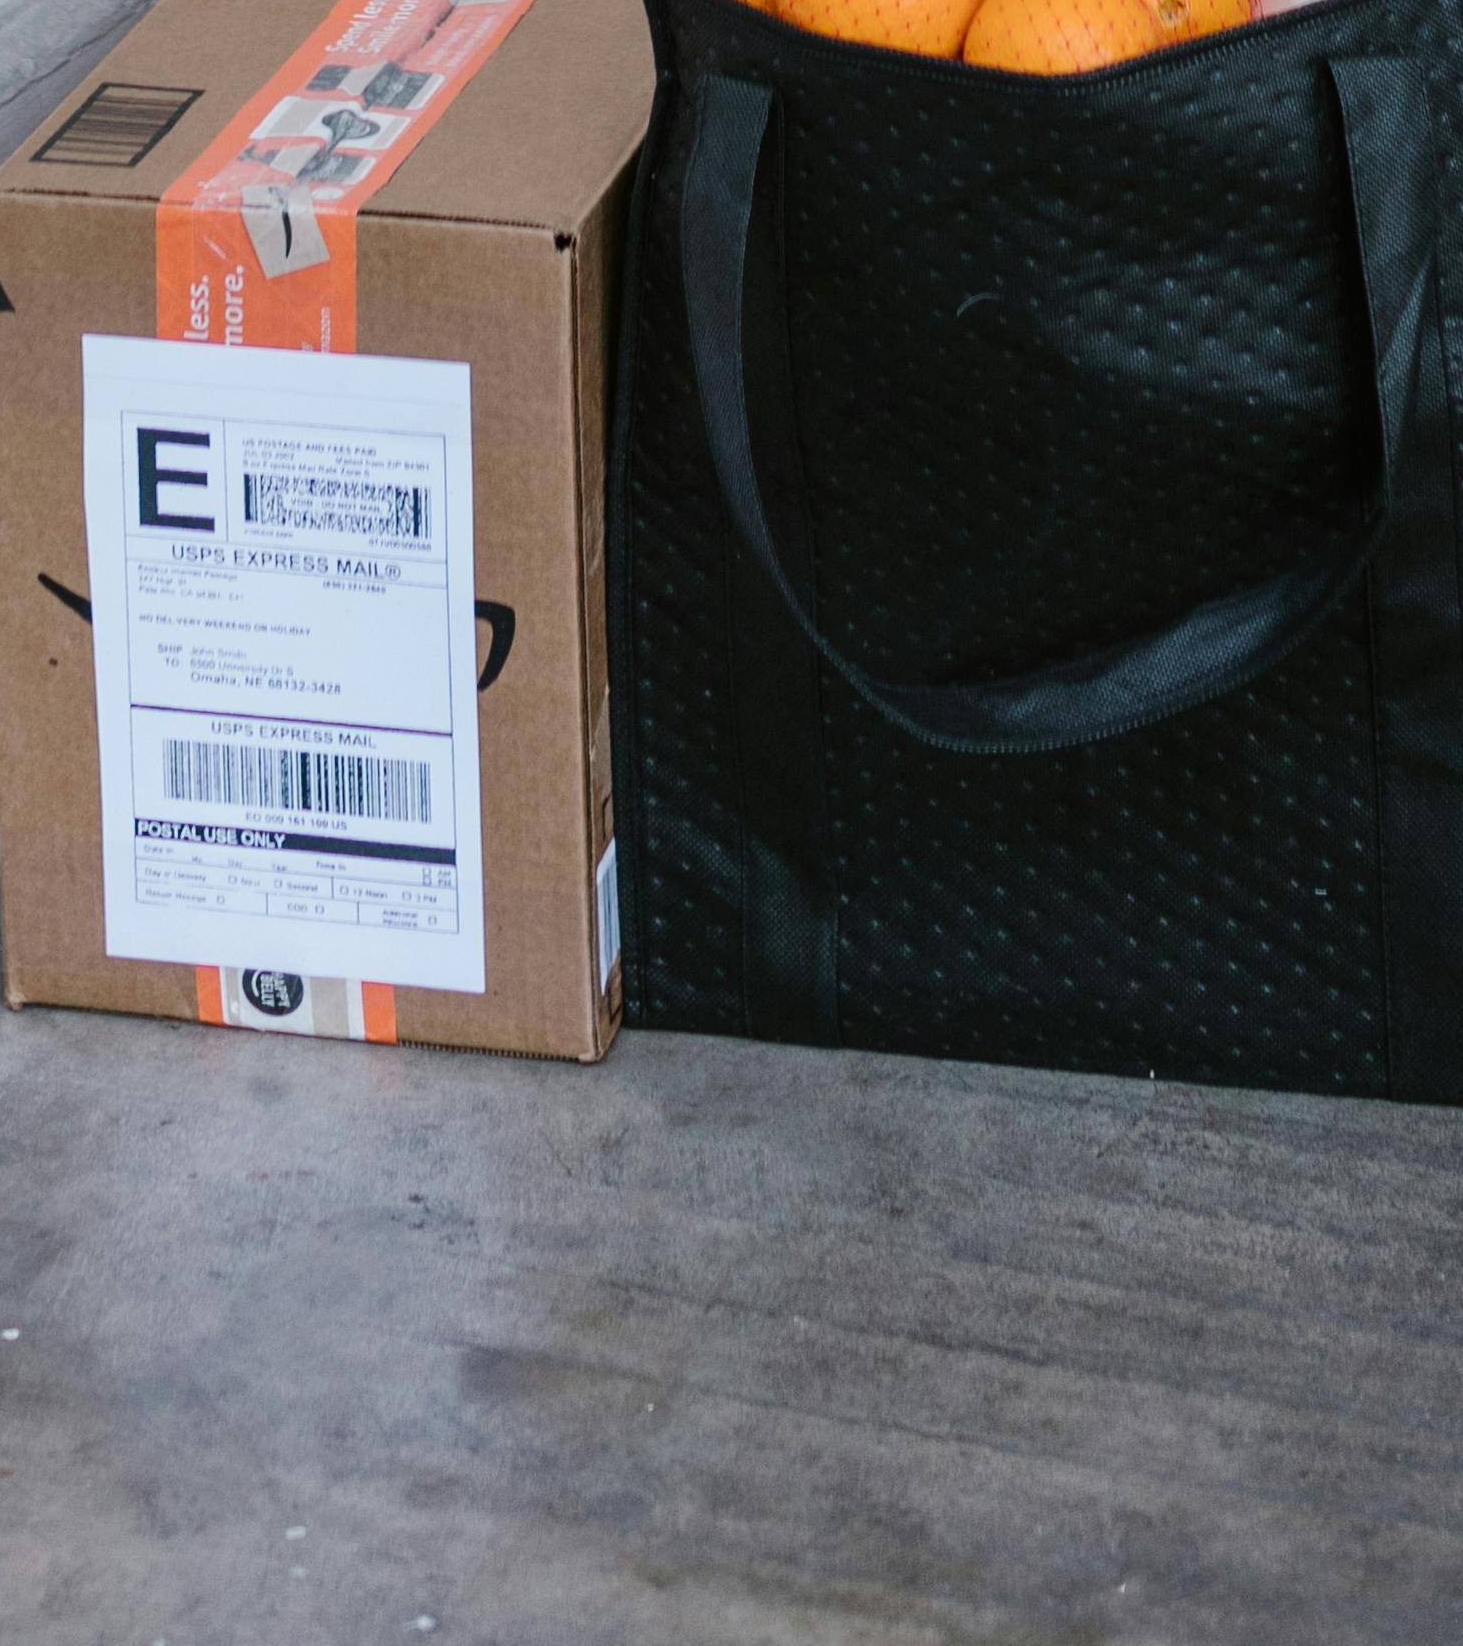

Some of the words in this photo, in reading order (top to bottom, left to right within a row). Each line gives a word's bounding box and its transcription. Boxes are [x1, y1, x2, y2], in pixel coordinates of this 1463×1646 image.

[325, 20, 370, 54] Spend
[183, 275, 210, 341] less.
[136, 428, 215, 533] E
[171, 544, 226, 564] USPS
[233, 549, 330, 574] EXPRESS
[157, 642, 183, 655] SHIP
[190, 671, 241, 688] Omaha,
[245, 676, 265, 689] NE
[211, 721, 254, 739] USPS
[259, 725, 334, 745] EXPRESS
[338, 732, 377, 750] MAIL
[137, 821, 203, 843] POSTAL
[204, 826, 238, 845] USE
[240, 830, 286, 850] ONLY
